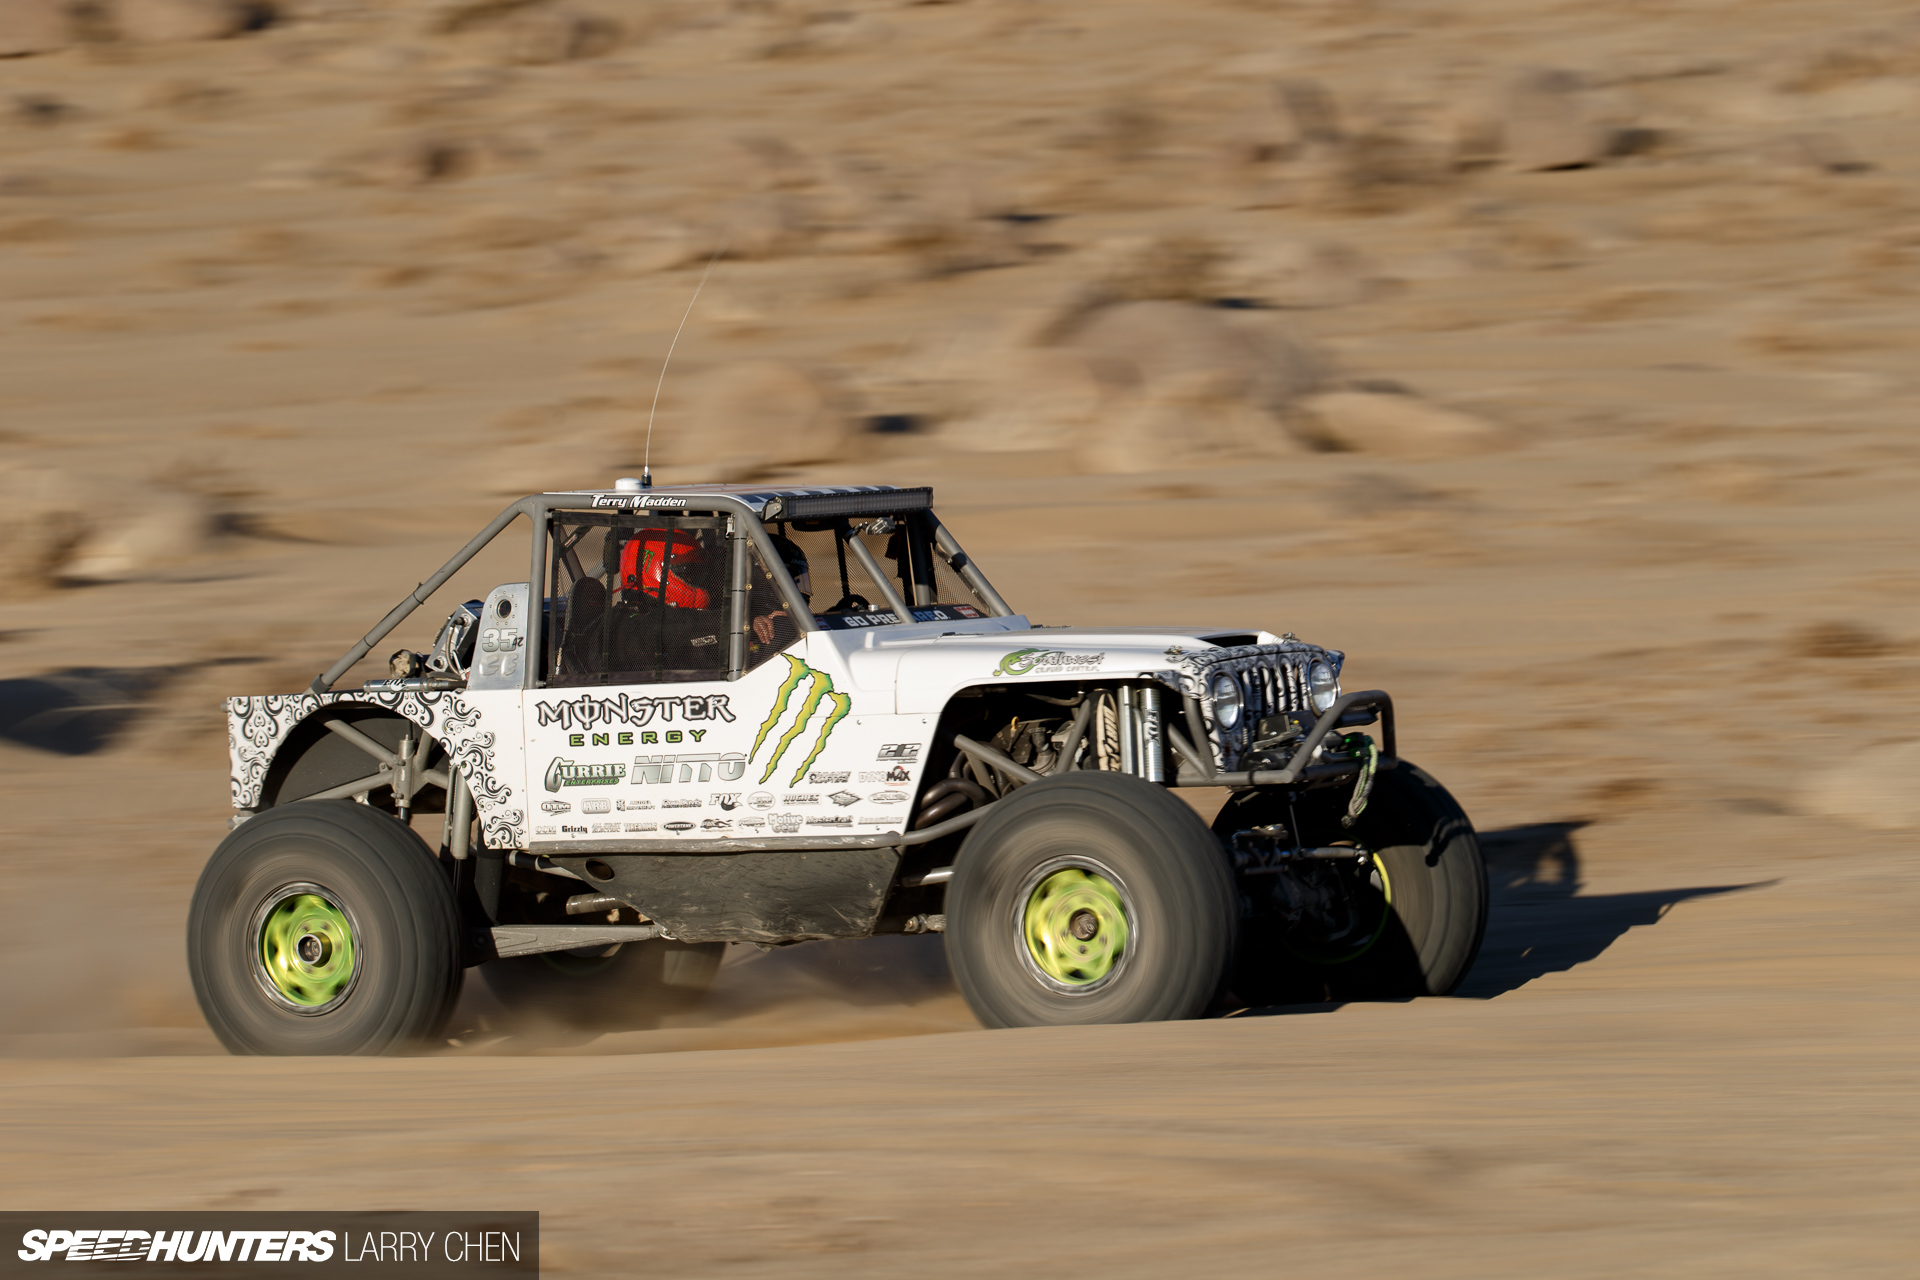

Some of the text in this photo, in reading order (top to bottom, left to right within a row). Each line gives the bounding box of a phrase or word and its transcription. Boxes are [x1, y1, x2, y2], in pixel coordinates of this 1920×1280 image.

[591, 494, 687, 508] Terry Madden
[482, 628, 517, 652] 35
[535, 693, 736, 730] MONSTER
[569, 729, 706, 747] ENERGY
[545, 756, 626, 793] CURRIE
[631, 752, 746, 784] NITTO
[563, 778, 619, 787] ENTERPRISES
[584, 800, 609, 811] ARB
[709, 793, 743, 810] FOX
[783, 794, 820, 803] HUGHES
[768, 813, 803, 825] Motive
[561, 825, 588, 834] Grizzly
[772, 823, 799, 833] Gear
